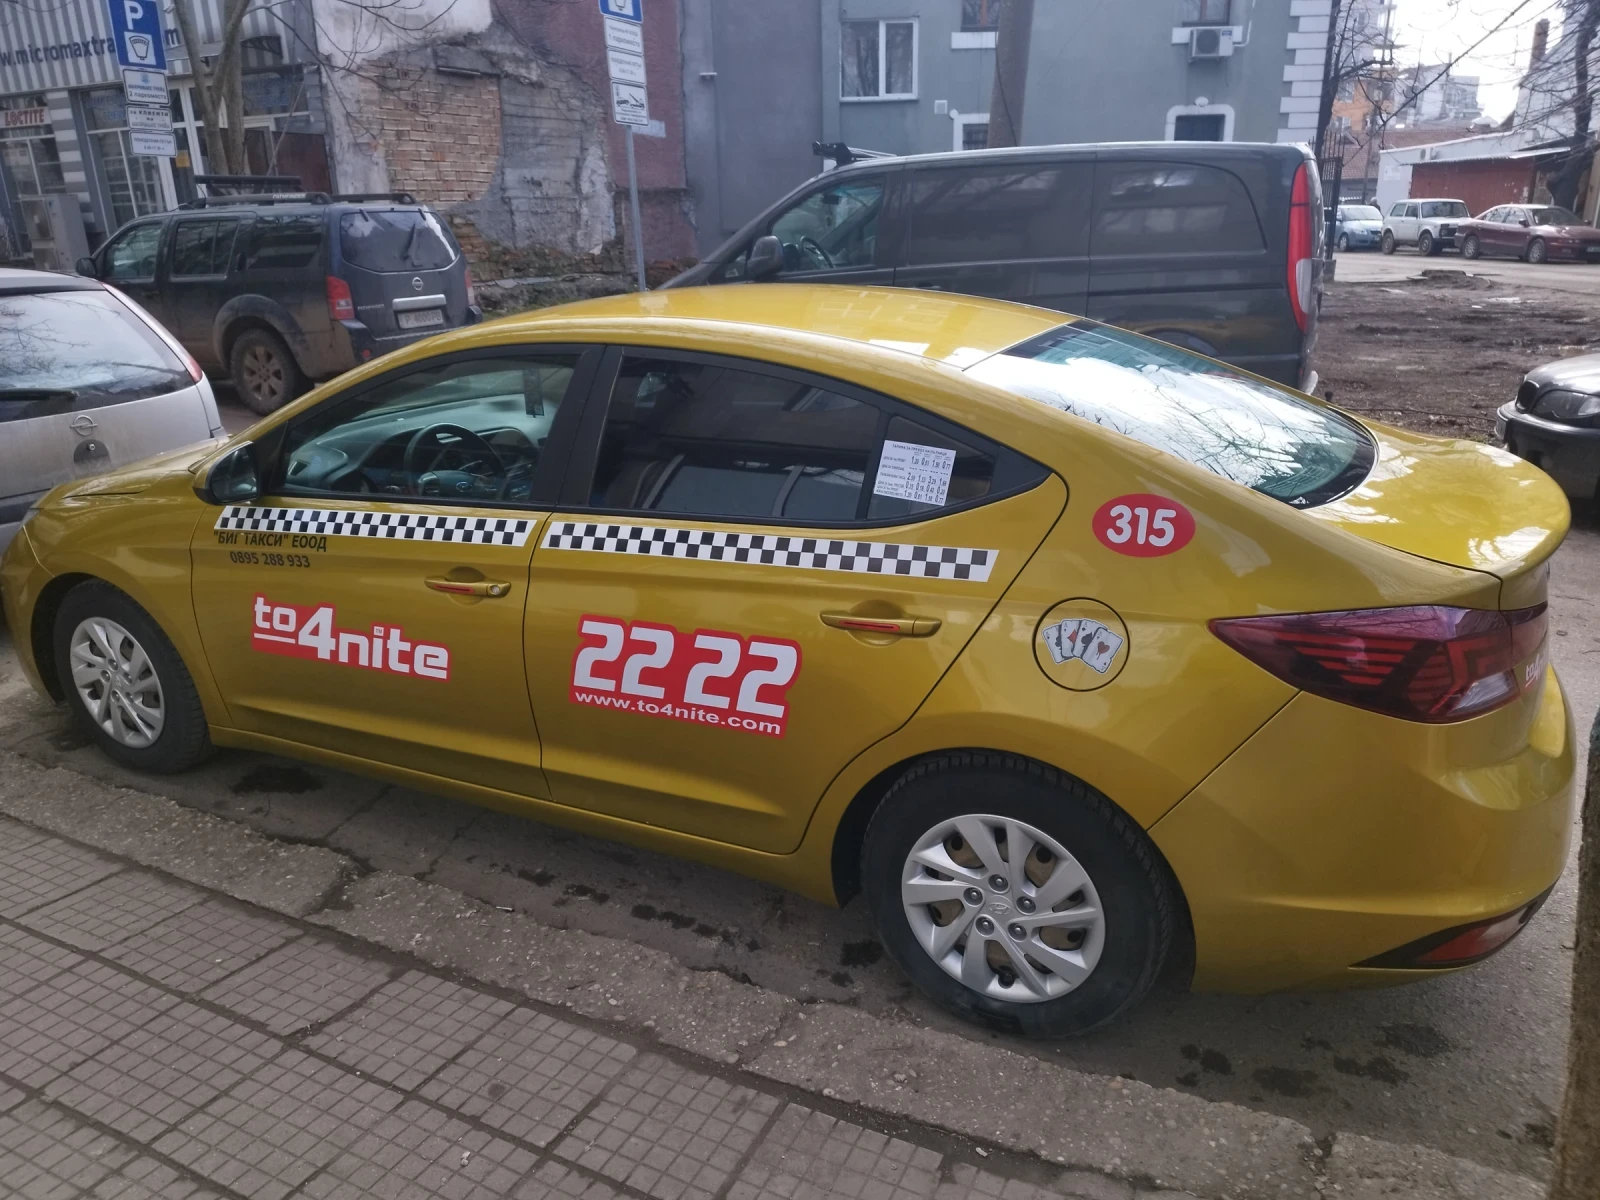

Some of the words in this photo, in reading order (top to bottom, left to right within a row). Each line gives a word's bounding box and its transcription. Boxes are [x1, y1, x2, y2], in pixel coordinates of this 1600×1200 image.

[124, 1, 143, 30] P
[5, 109, 44, 126] LOCTITE
[1106, 504, 1177, 547] 315
[244, 532, 289, 547] ТАКСИ"
[291, 535, 327, 552] ЕООД
[230, 551, 259, 564] 0895
[261, 553, 285, 566] 288
[287, 554, 311, 568] 933
[254, 597, 449, 679] to4nite
[575, 691, 781, 735] www.to4nite.com
